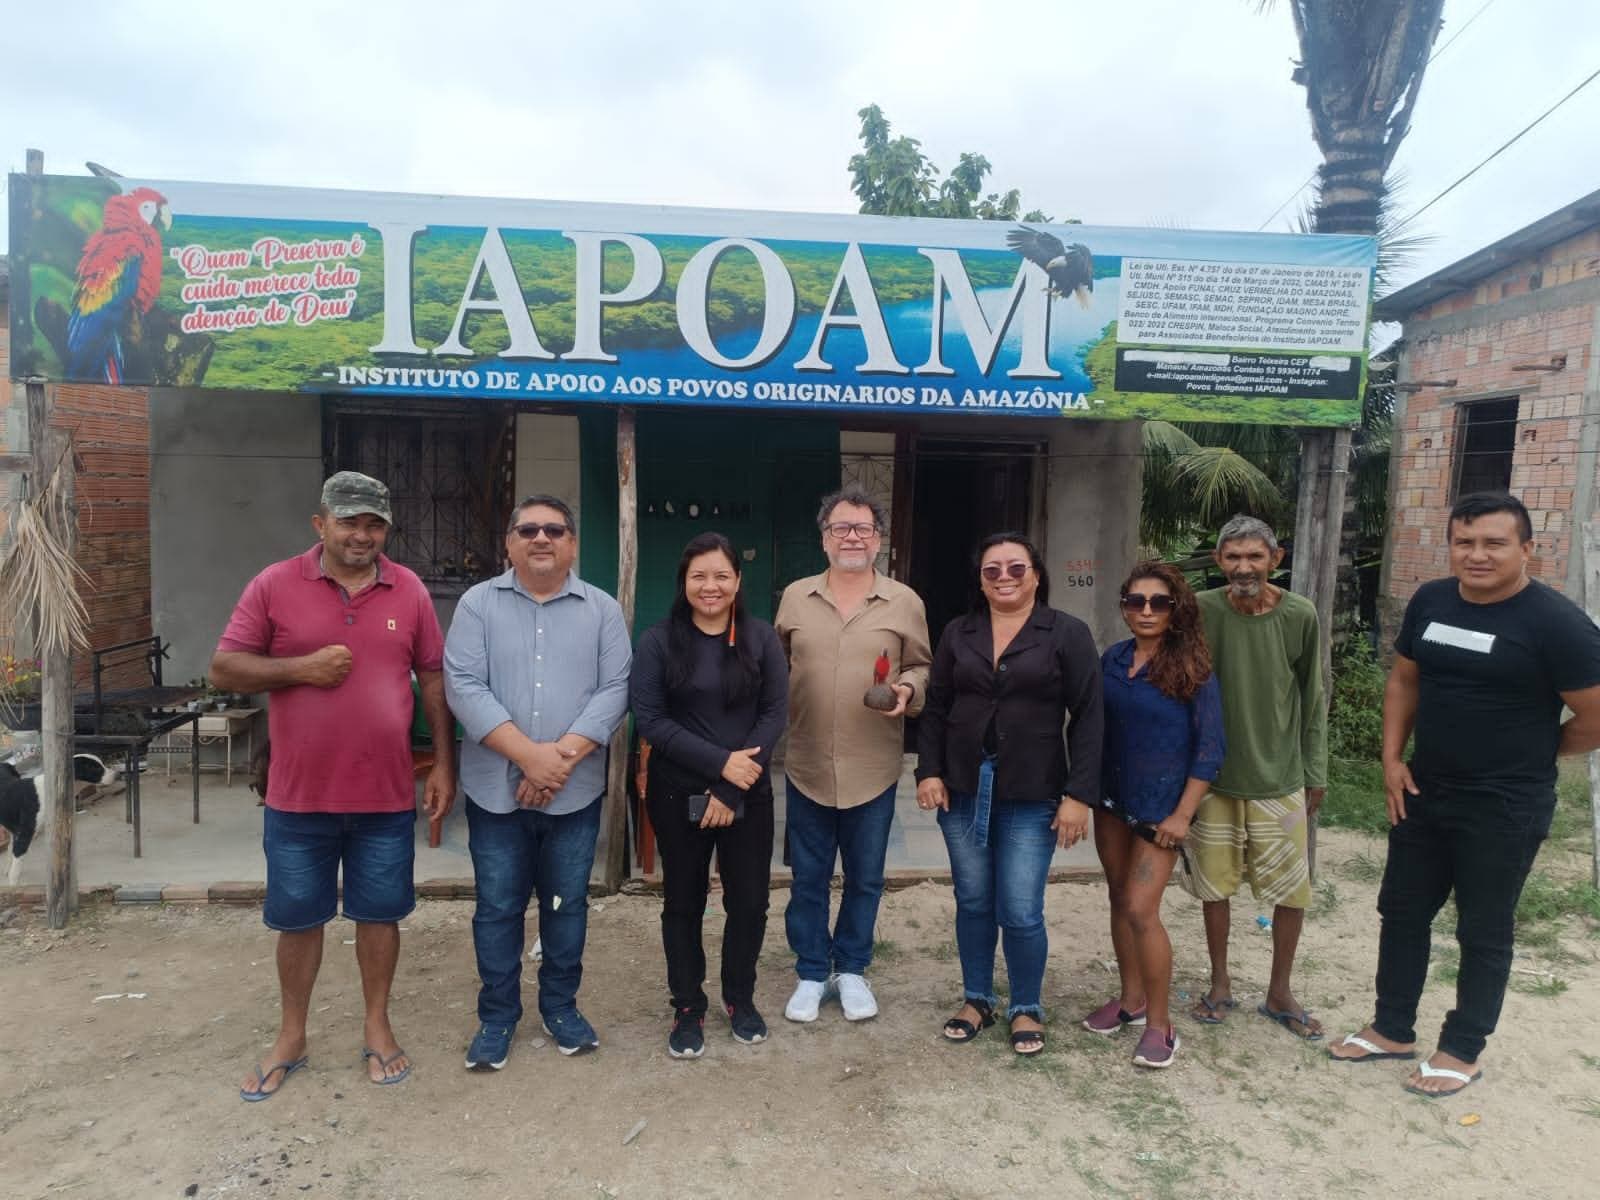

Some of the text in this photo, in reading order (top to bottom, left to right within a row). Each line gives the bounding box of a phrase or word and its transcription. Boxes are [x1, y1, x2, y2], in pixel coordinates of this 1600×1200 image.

[254, 239, 346, 268] Preserva
[351, 235, 362, 255] é
[184, 265, 357, 300] cuida merece toda
[1218, 286, 1242, 294] CRUZ
[1244, 286, 1290, 296] VERMELHA
[369, 223, 1062, 378] IAPOAM
[184, 305, 257, 331] atenção
[264, 299, 286, 322] de
[1158, 331, 1204, 340] Associados
[1266, 326, 1316, 335] Atendimento
[1232, 356, 1308, 366] Bairro Teixeira CEP
[1190, 364, 1232, 372] Amazonas
[1234, 365, 1264, 374] Contato
[486, 370, 520, 390] DE
[526, 372, 606, 392] APOIO
[612, 374, 661, 395] AOS
[667, 377, 748, 399] POVOS
[753, 382, 916, 406] ORIGINARIOS
[920, 387, 955, 407] DA
[1186, 382, 1212, 391] Povos
[1068, 576, 1094, 587] 560
